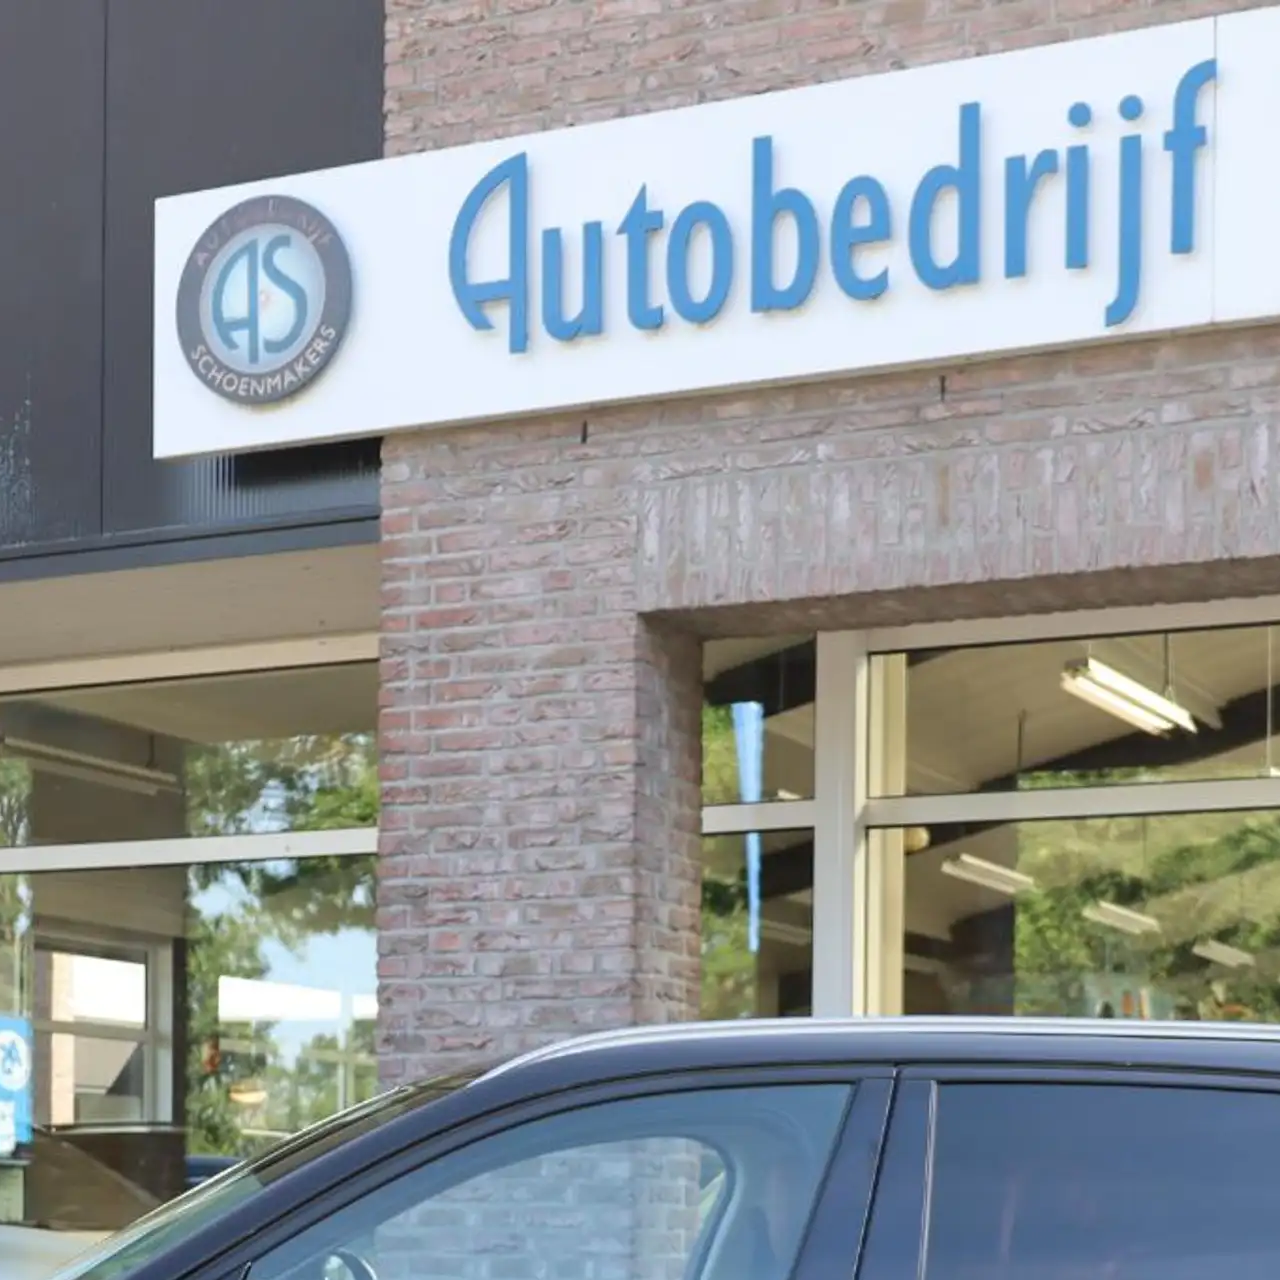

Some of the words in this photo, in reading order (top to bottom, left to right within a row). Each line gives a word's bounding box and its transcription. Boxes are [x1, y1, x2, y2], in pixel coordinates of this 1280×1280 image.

[448, 58, 1217, 354] Autobedrijf
[190, 324, 336, 396] SCHOENMAKERS
[211, 235, 308, 364] AS
